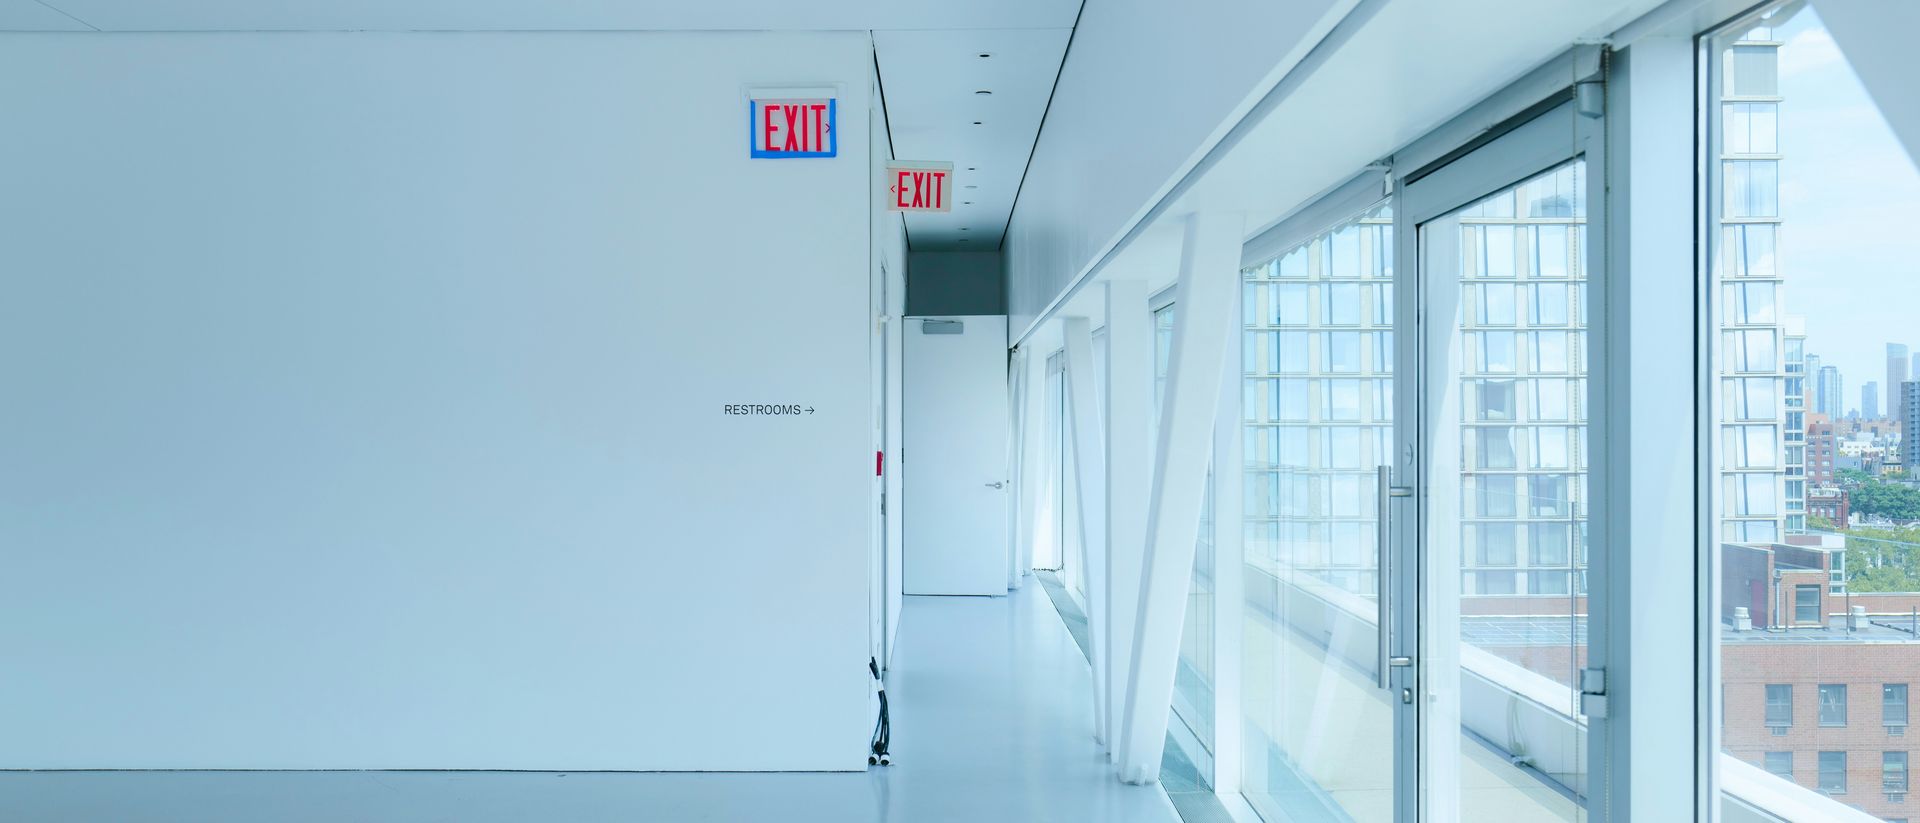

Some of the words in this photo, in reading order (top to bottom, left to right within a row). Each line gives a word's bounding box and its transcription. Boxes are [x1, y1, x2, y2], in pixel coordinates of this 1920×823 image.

[764, 104, 826, 152] EXIT
[897, 171, 945, 209] EXIT
[724, 404, 801, 415] RESTROOMS
